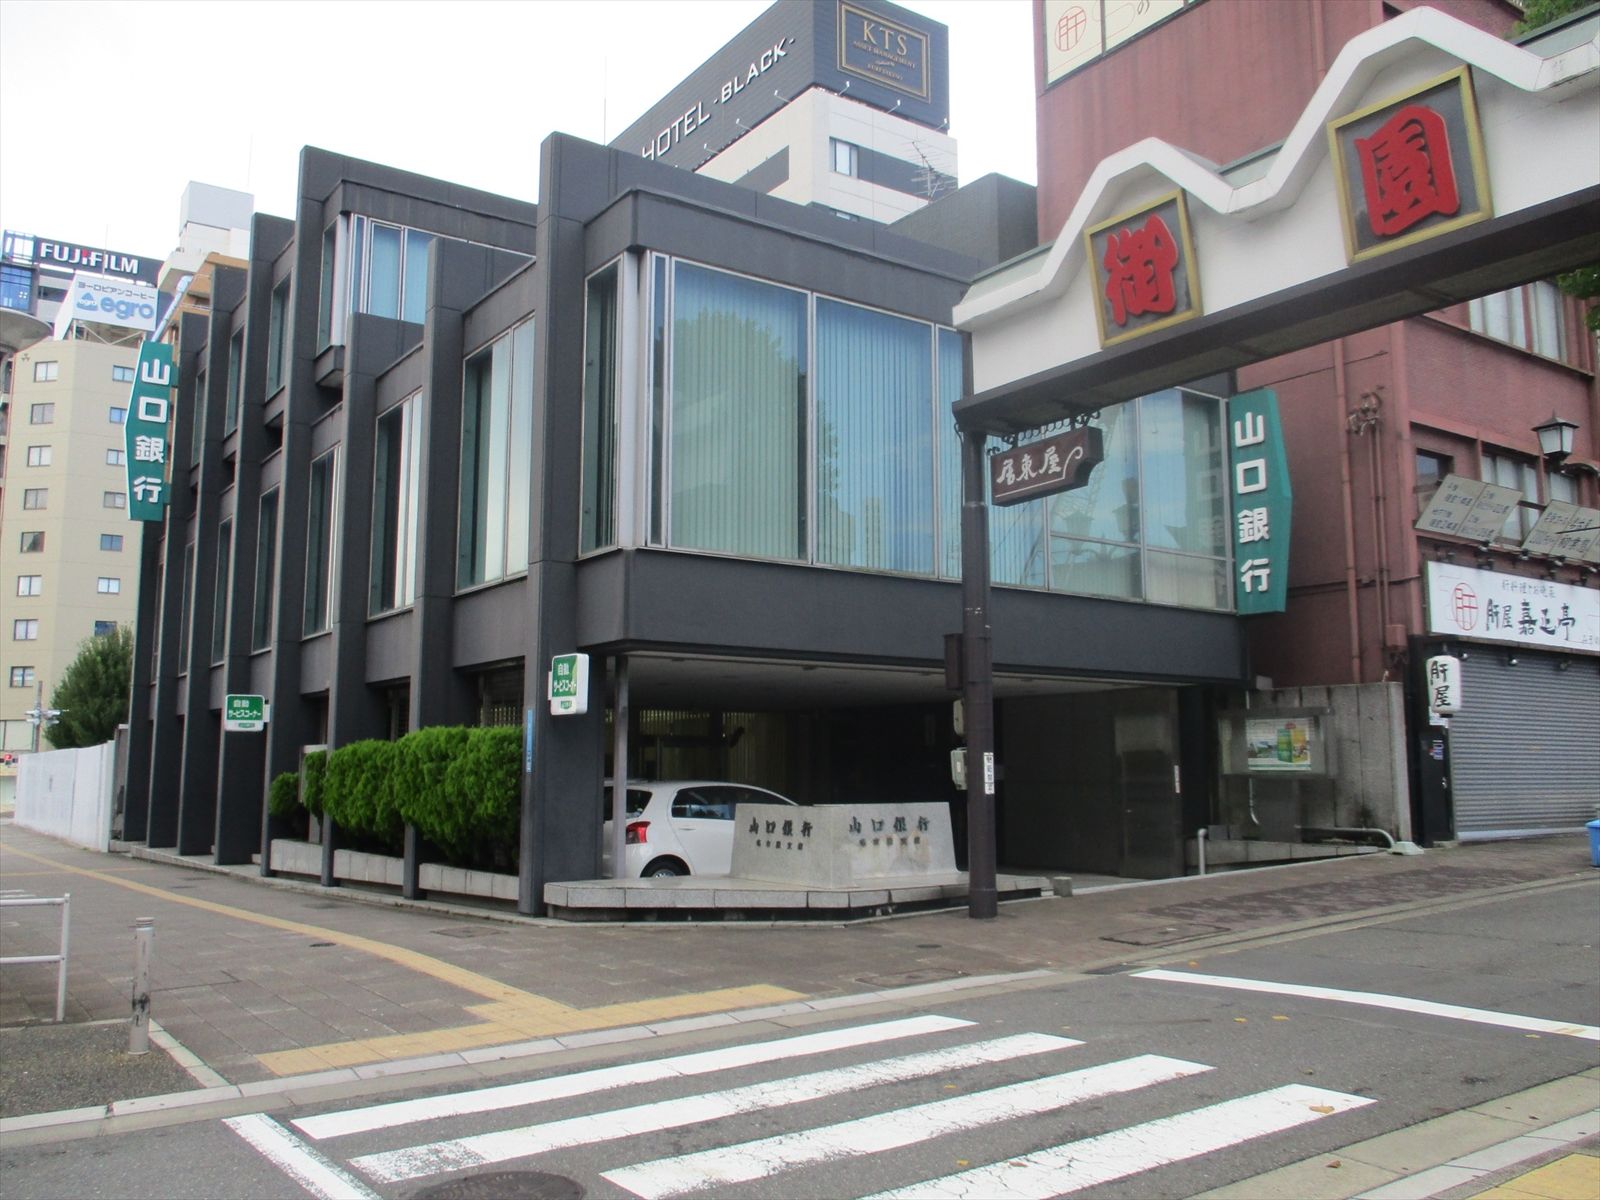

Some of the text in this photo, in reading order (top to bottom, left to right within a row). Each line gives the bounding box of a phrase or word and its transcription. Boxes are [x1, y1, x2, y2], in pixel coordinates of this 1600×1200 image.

[863, 20, 908, 56] KTS
[642, 101, 711, 160] HOTEL
[100, 296, 154, 320] egro
[133, 358, 171, 504] 山口銀行
[1234, 411, 1271, 593] 山口銀行
[1430, 660, 1452, 707] 肝屋
[228, 710, 262, 718] サービスコーナー
[233, 700, 250, 708] 自動
[749, 816, 813, 837] 山口銀行
[849, 816, 930, 833] 山口銀行
